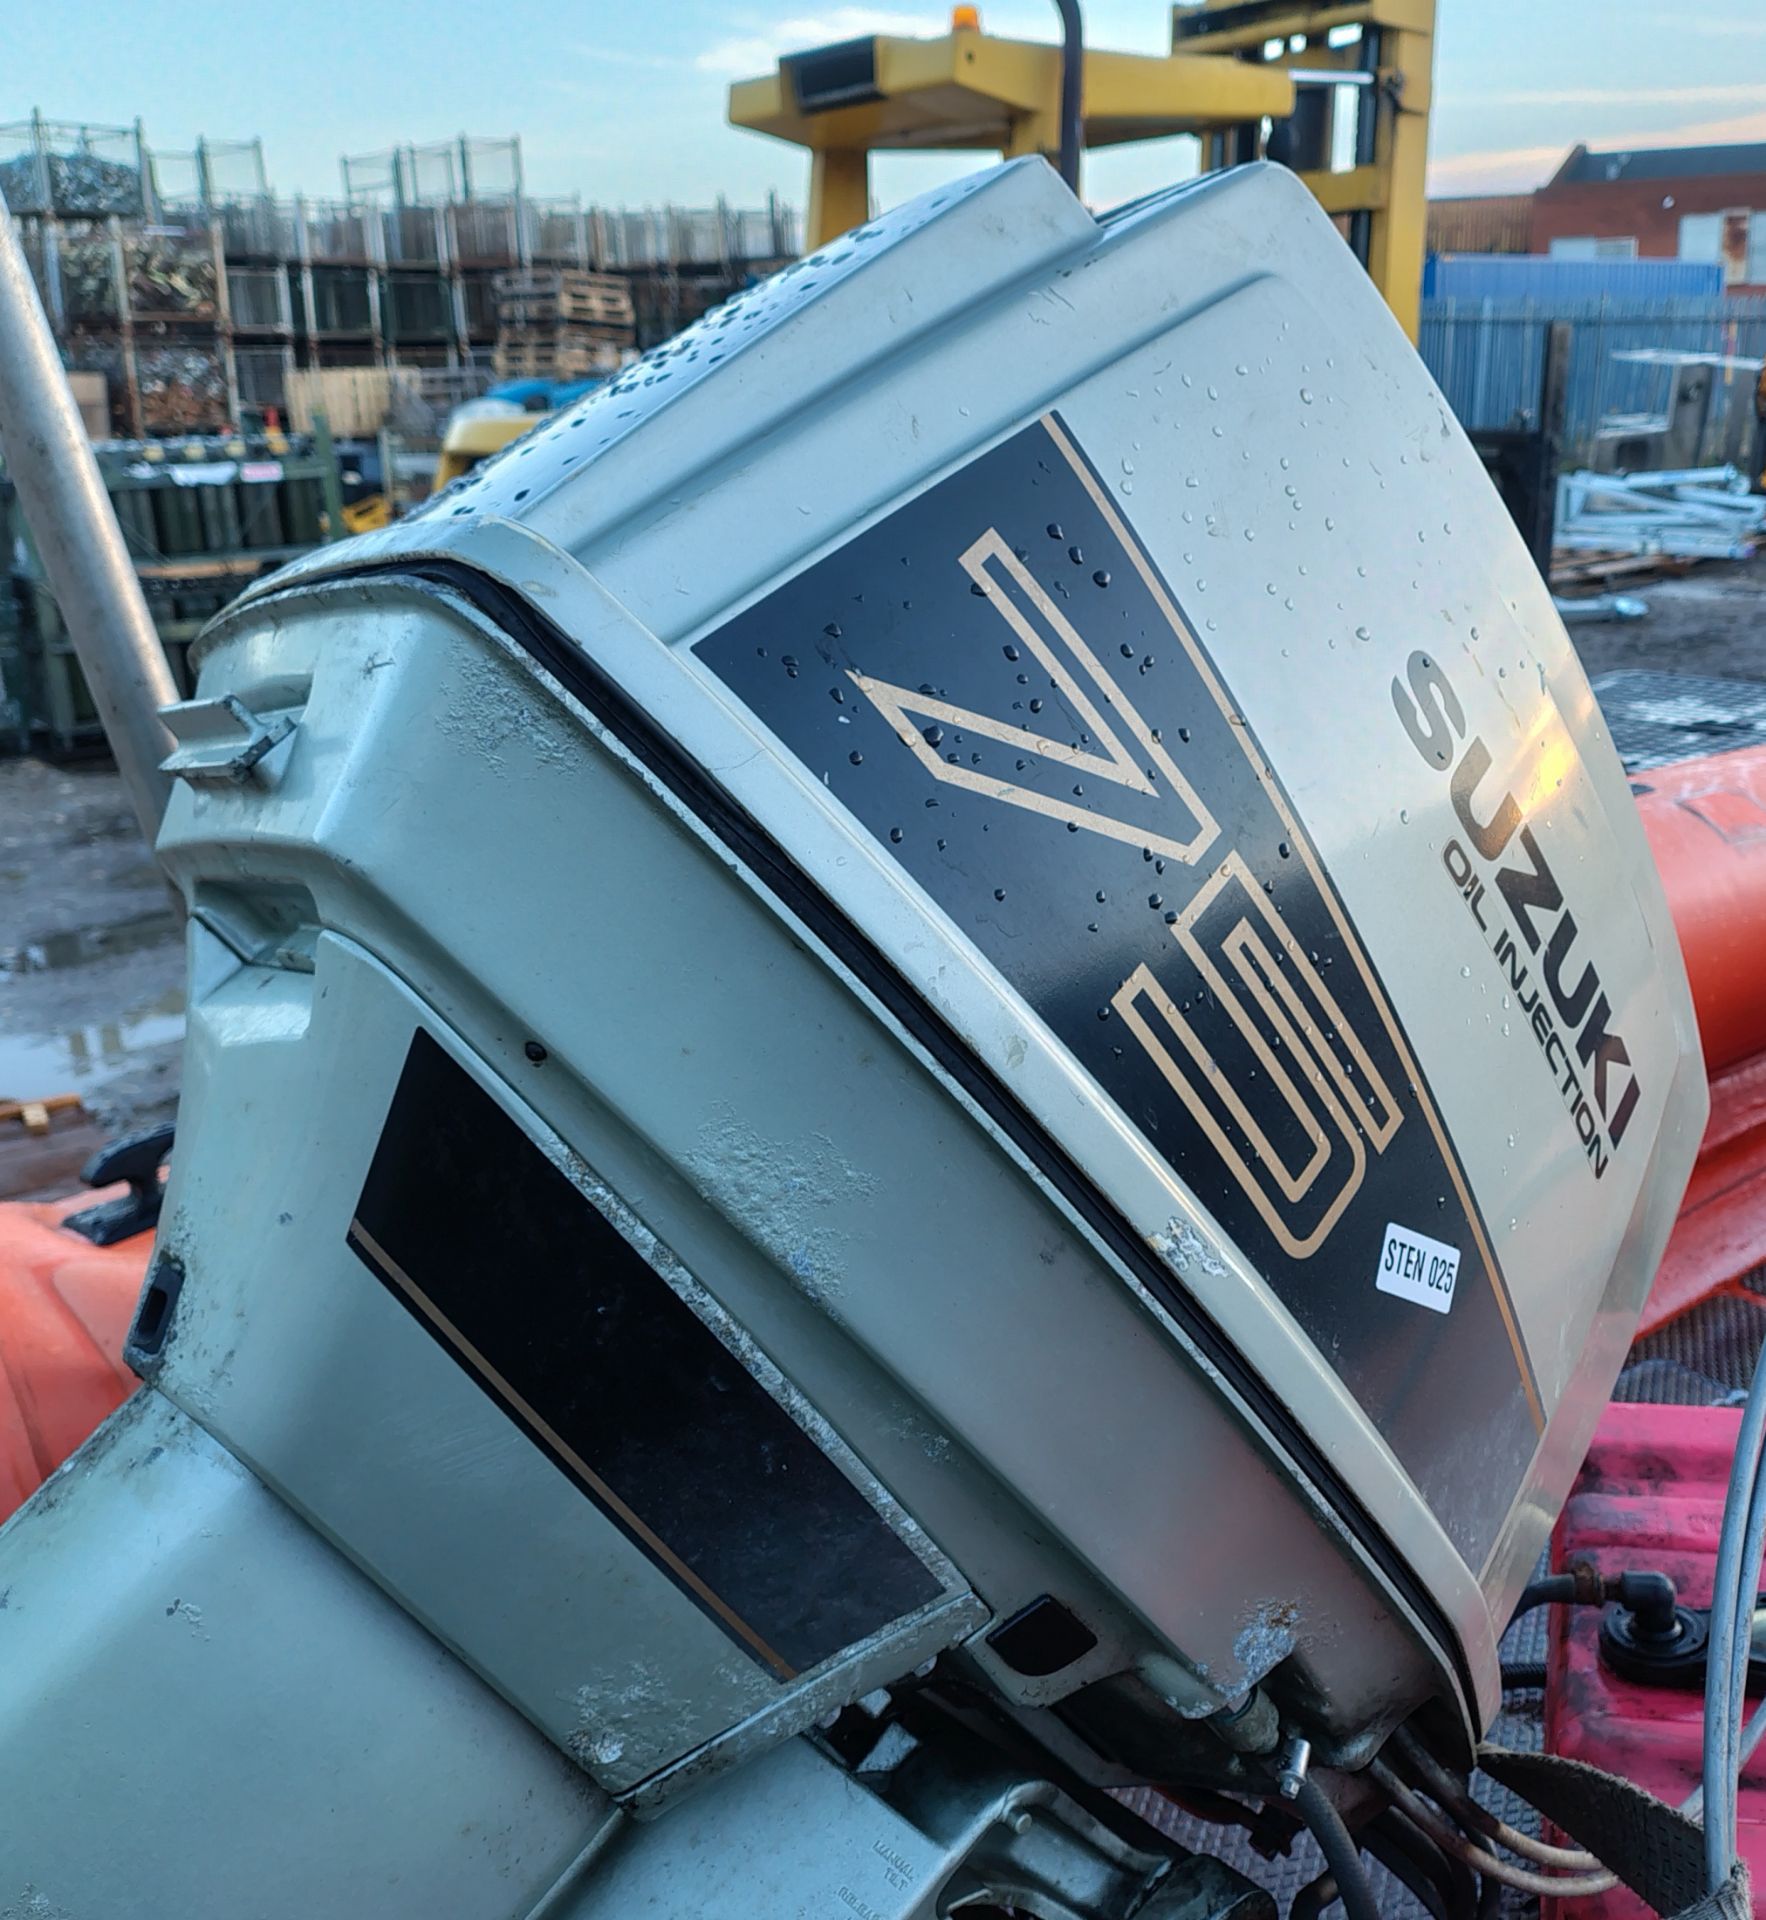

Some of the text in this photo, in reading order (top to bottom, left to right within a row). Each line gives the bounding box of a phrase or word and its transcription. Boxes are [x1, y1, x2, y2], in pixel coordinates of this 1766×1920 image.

[844, 527, 1404, 1260] 75
[1391, 649, 1641, 1150] SUZUKI
[1443, 839, 1608, 1180] OIL INJECTION
[1384, 1238, 1455, 1294] STEN 025
[872, 1839, 914, 1881] MANUAL
